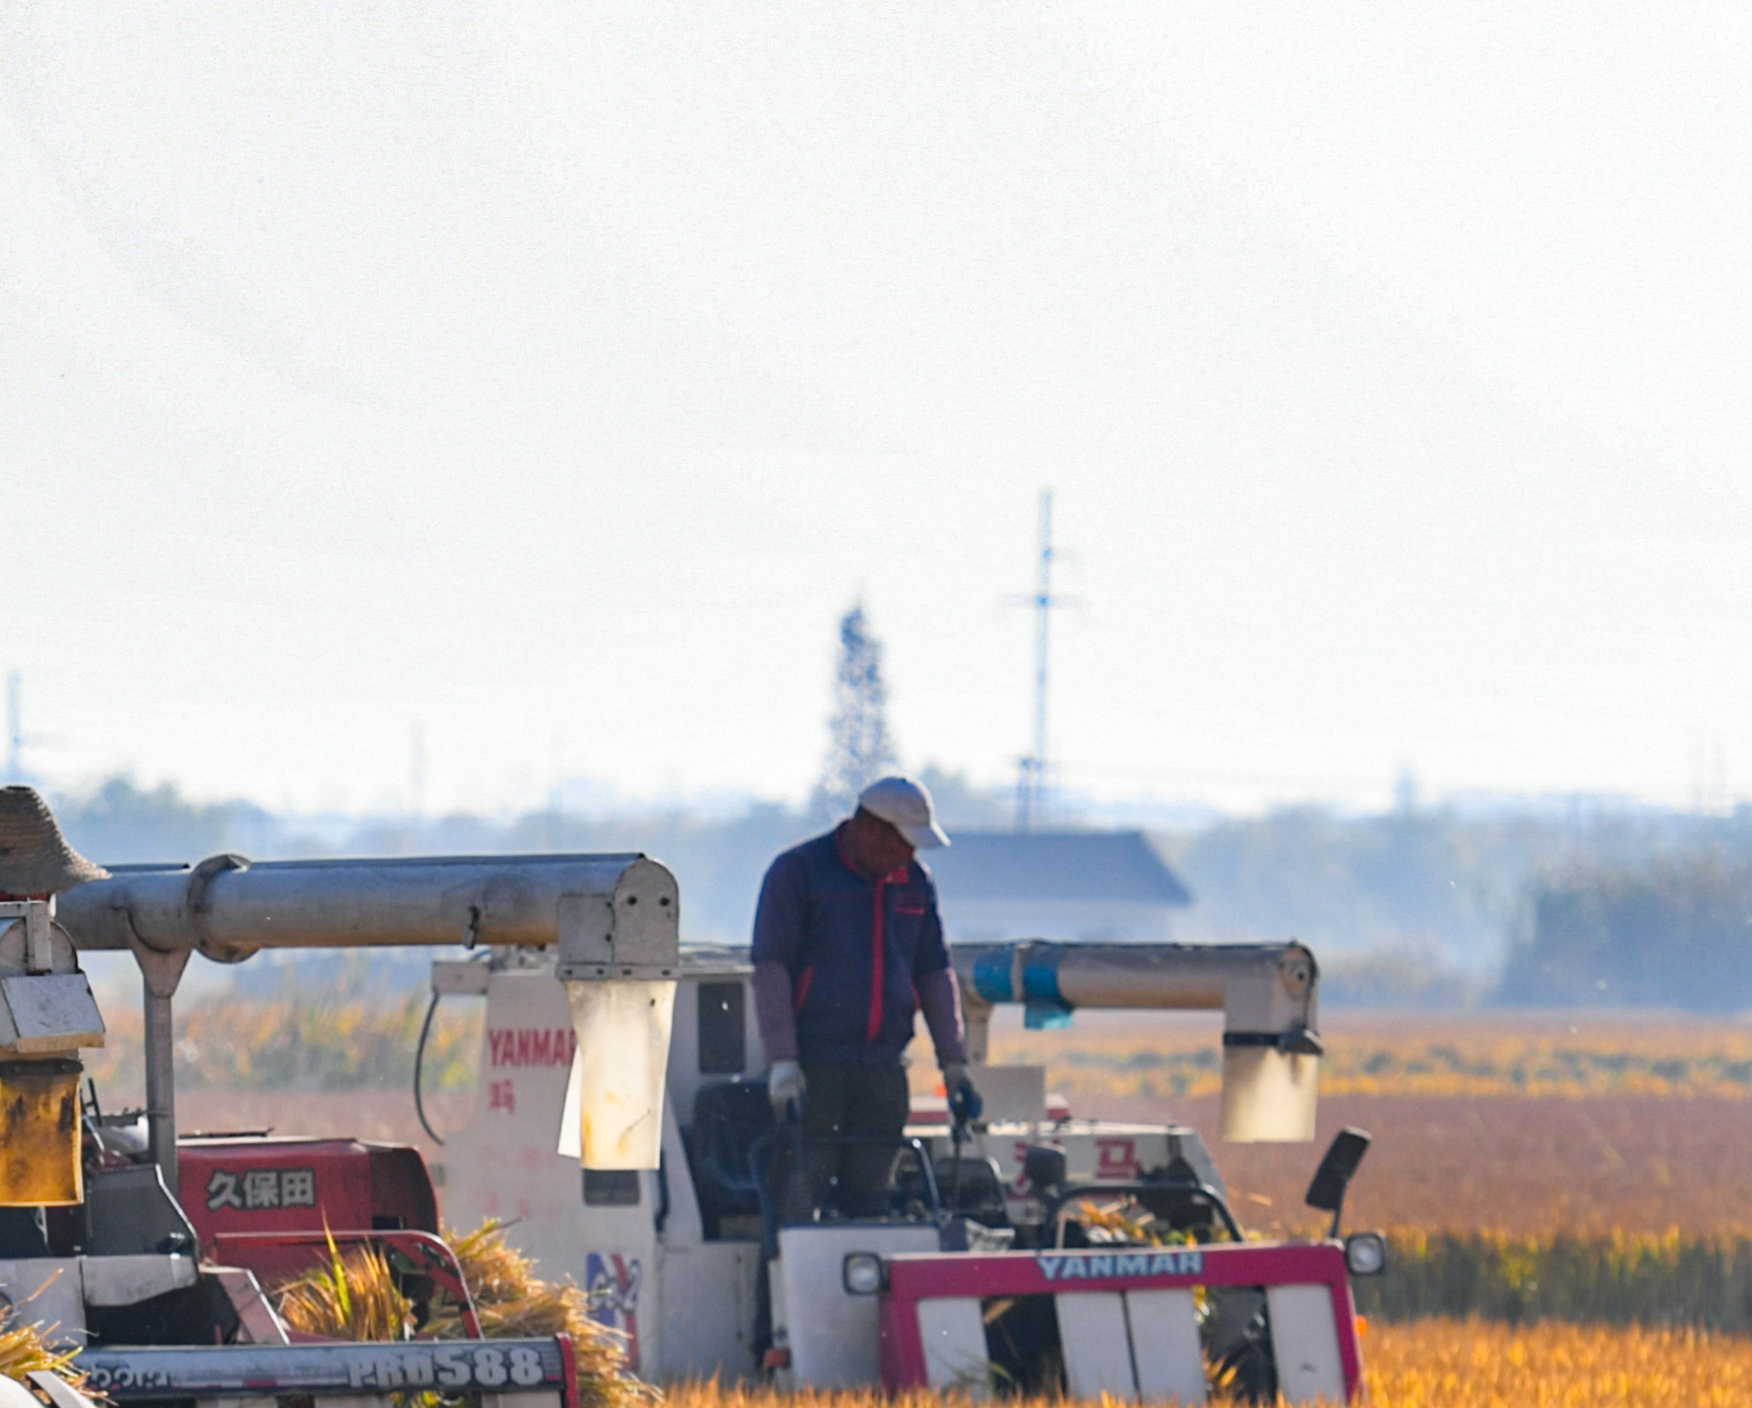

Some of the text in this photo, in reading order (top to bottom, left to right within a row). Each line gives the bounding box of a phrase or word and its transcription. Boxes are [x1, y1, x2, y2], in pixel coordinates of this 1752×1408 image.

[206, 1167, 317, 1212] 久保田
[1036, 1252, 1204, 1281] YANMAR
[348, 1346, 545, 1390] PRO588
